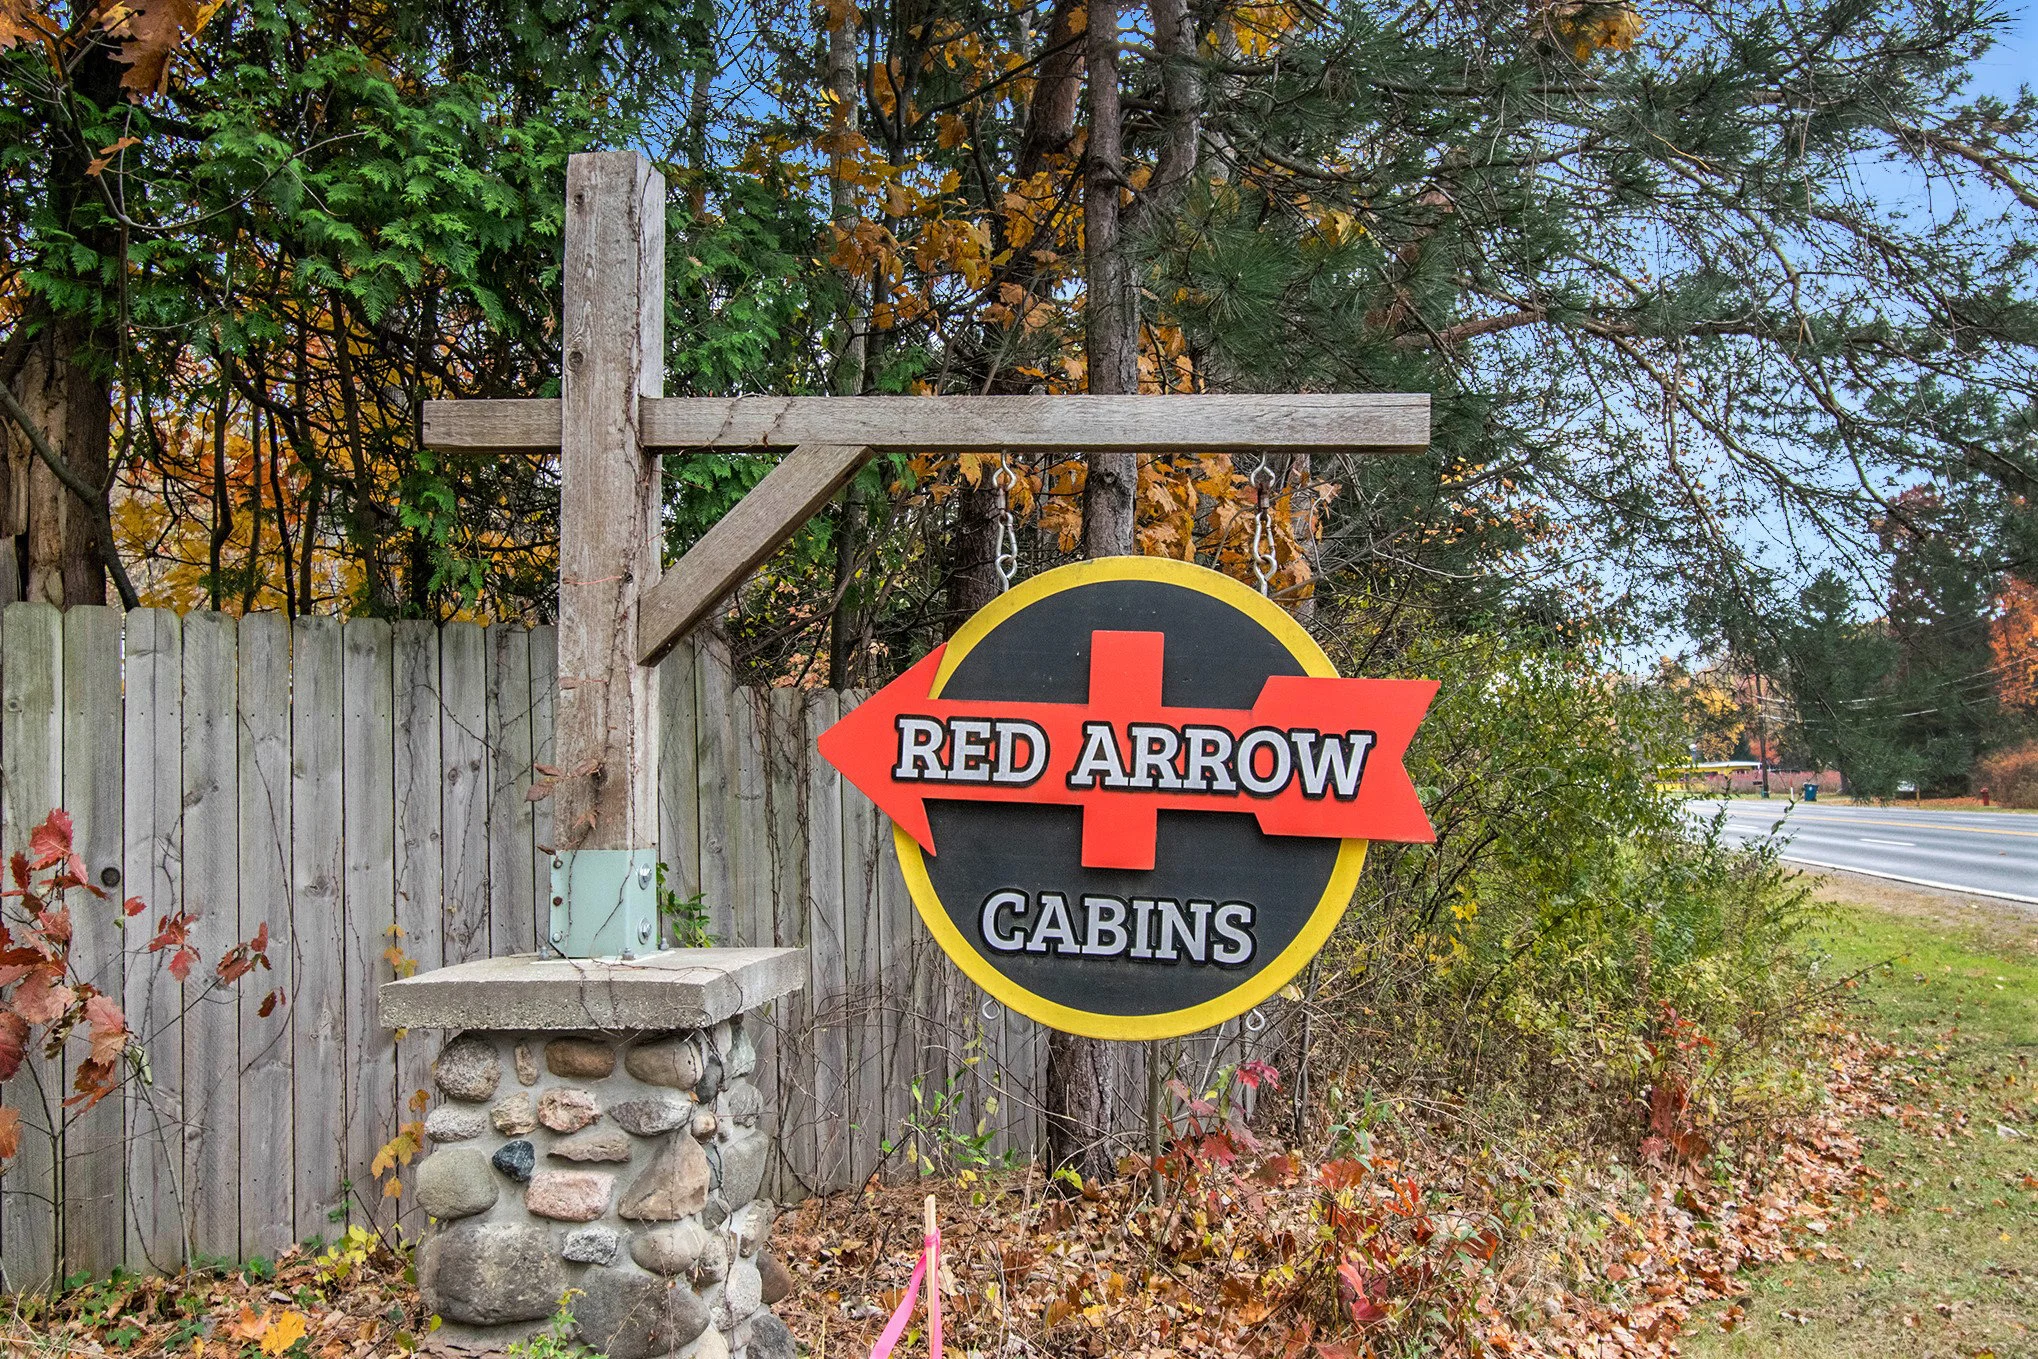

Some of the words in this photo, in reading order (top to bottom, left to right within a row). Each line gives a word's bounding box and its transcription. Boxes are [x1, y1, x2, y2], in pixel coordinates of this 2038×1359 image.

[894, 717, 1048, 784] RED
[1069, 723, 1375, 799] ARROW
[981, 891, 1254, 963] CABINS
